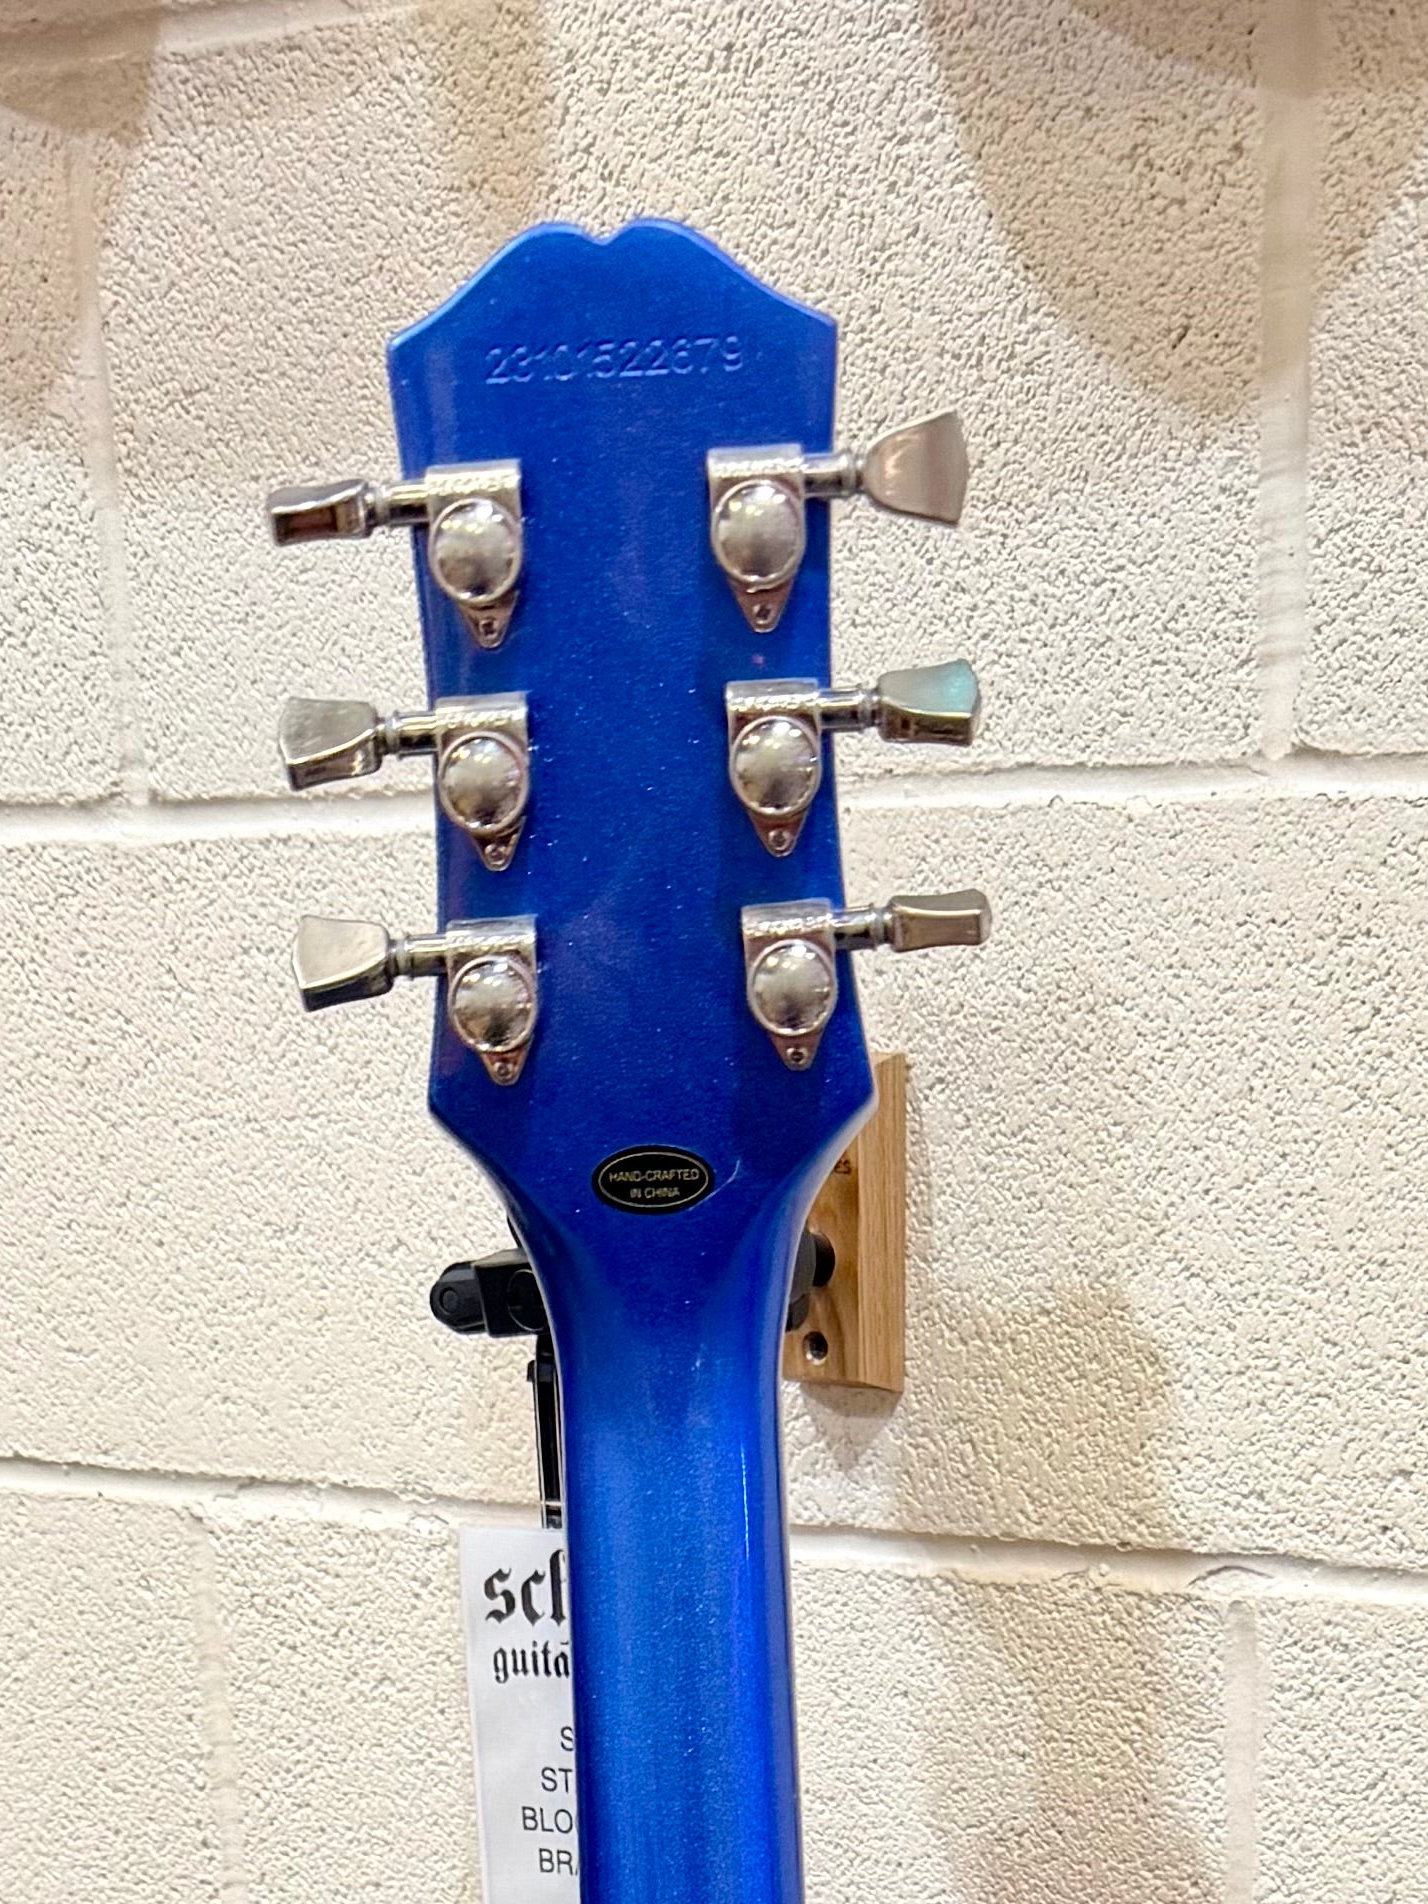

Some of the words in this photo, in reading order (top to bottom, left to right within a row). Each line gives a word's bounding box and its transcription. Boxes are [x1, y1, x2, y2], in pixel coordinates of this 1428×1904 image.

[608, 1168, 700, 1183] HAND-CRAFTED
[644, 1186, 681, 1199] CHINA
[521, 1805, 579, 1834] BLO
[538, 1848, 579, 1876] BR
